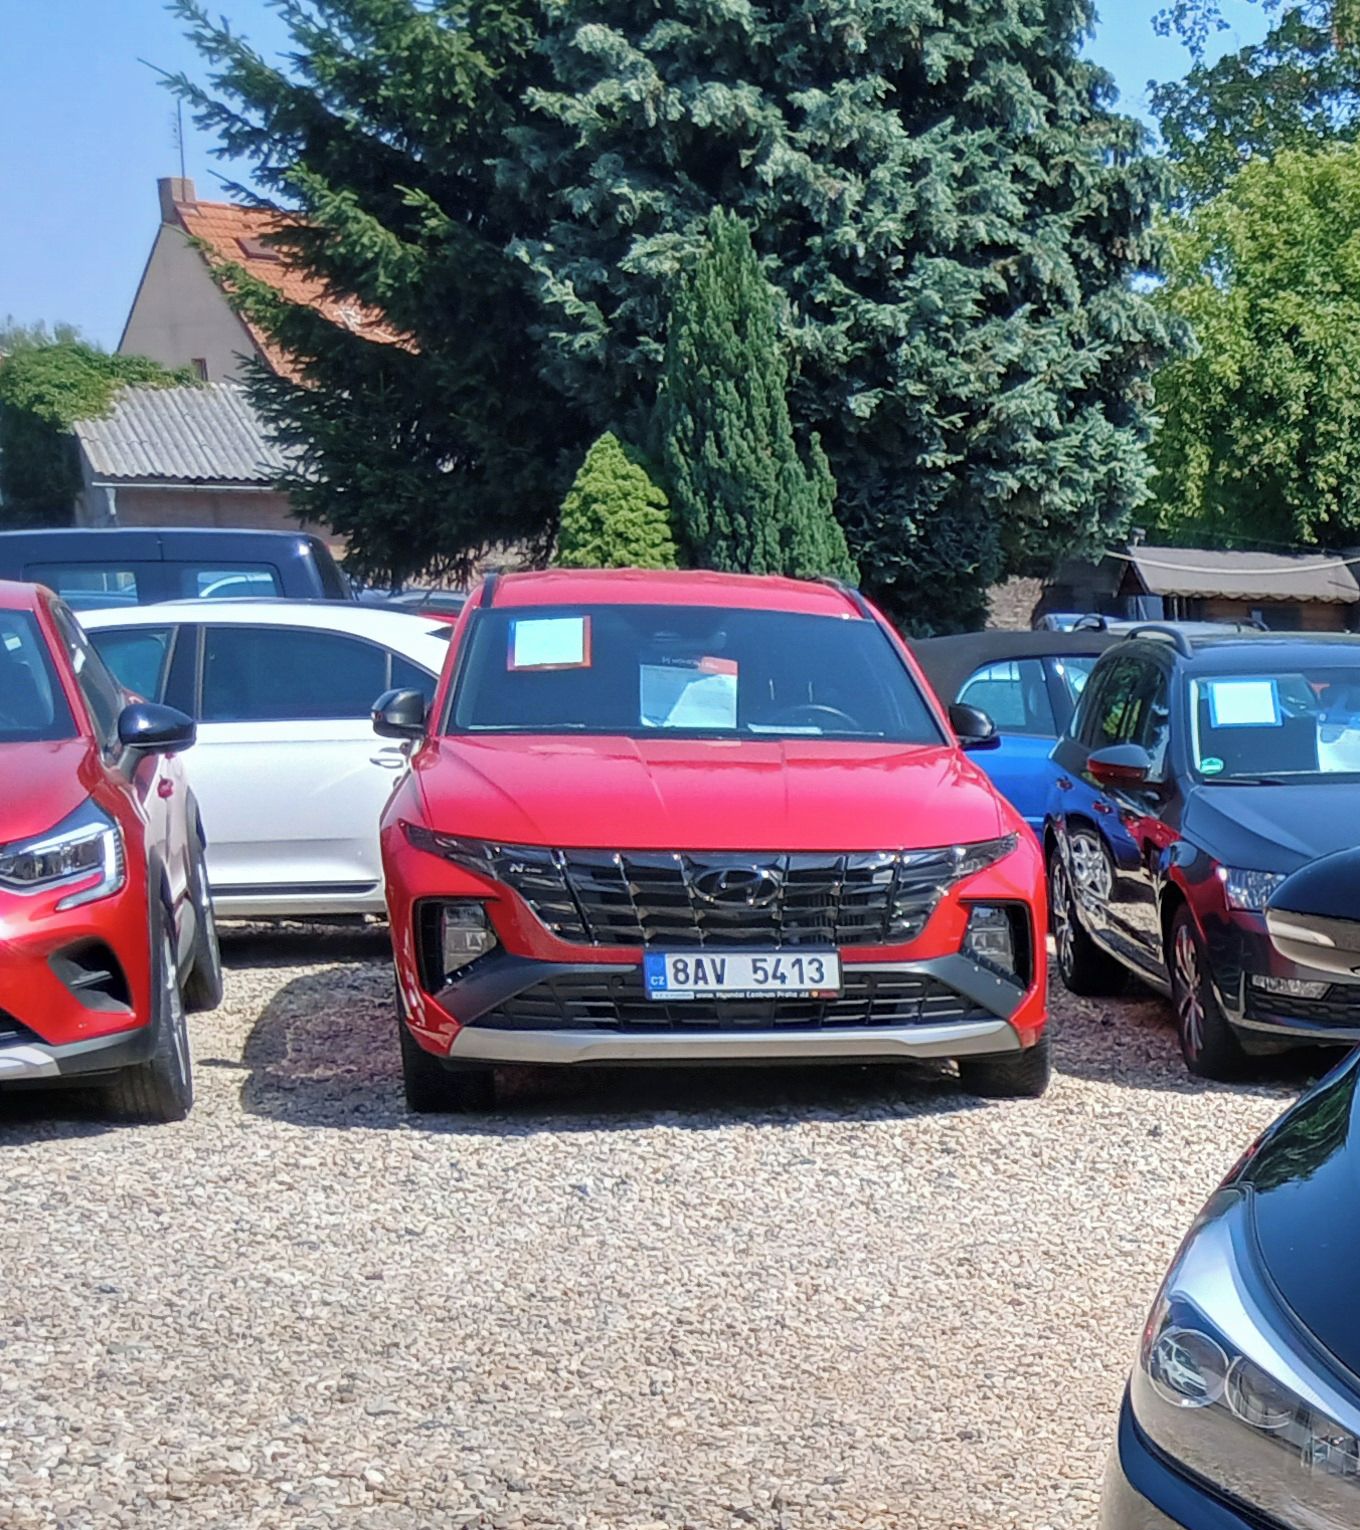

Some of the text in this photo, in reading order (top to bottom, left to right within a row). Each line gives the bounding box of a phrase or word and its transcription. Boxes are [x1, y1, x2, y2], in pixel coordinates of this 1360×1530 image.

[650, 975, 665, 986] CZ
[672, 957, 825, 985] 8AV 5413
